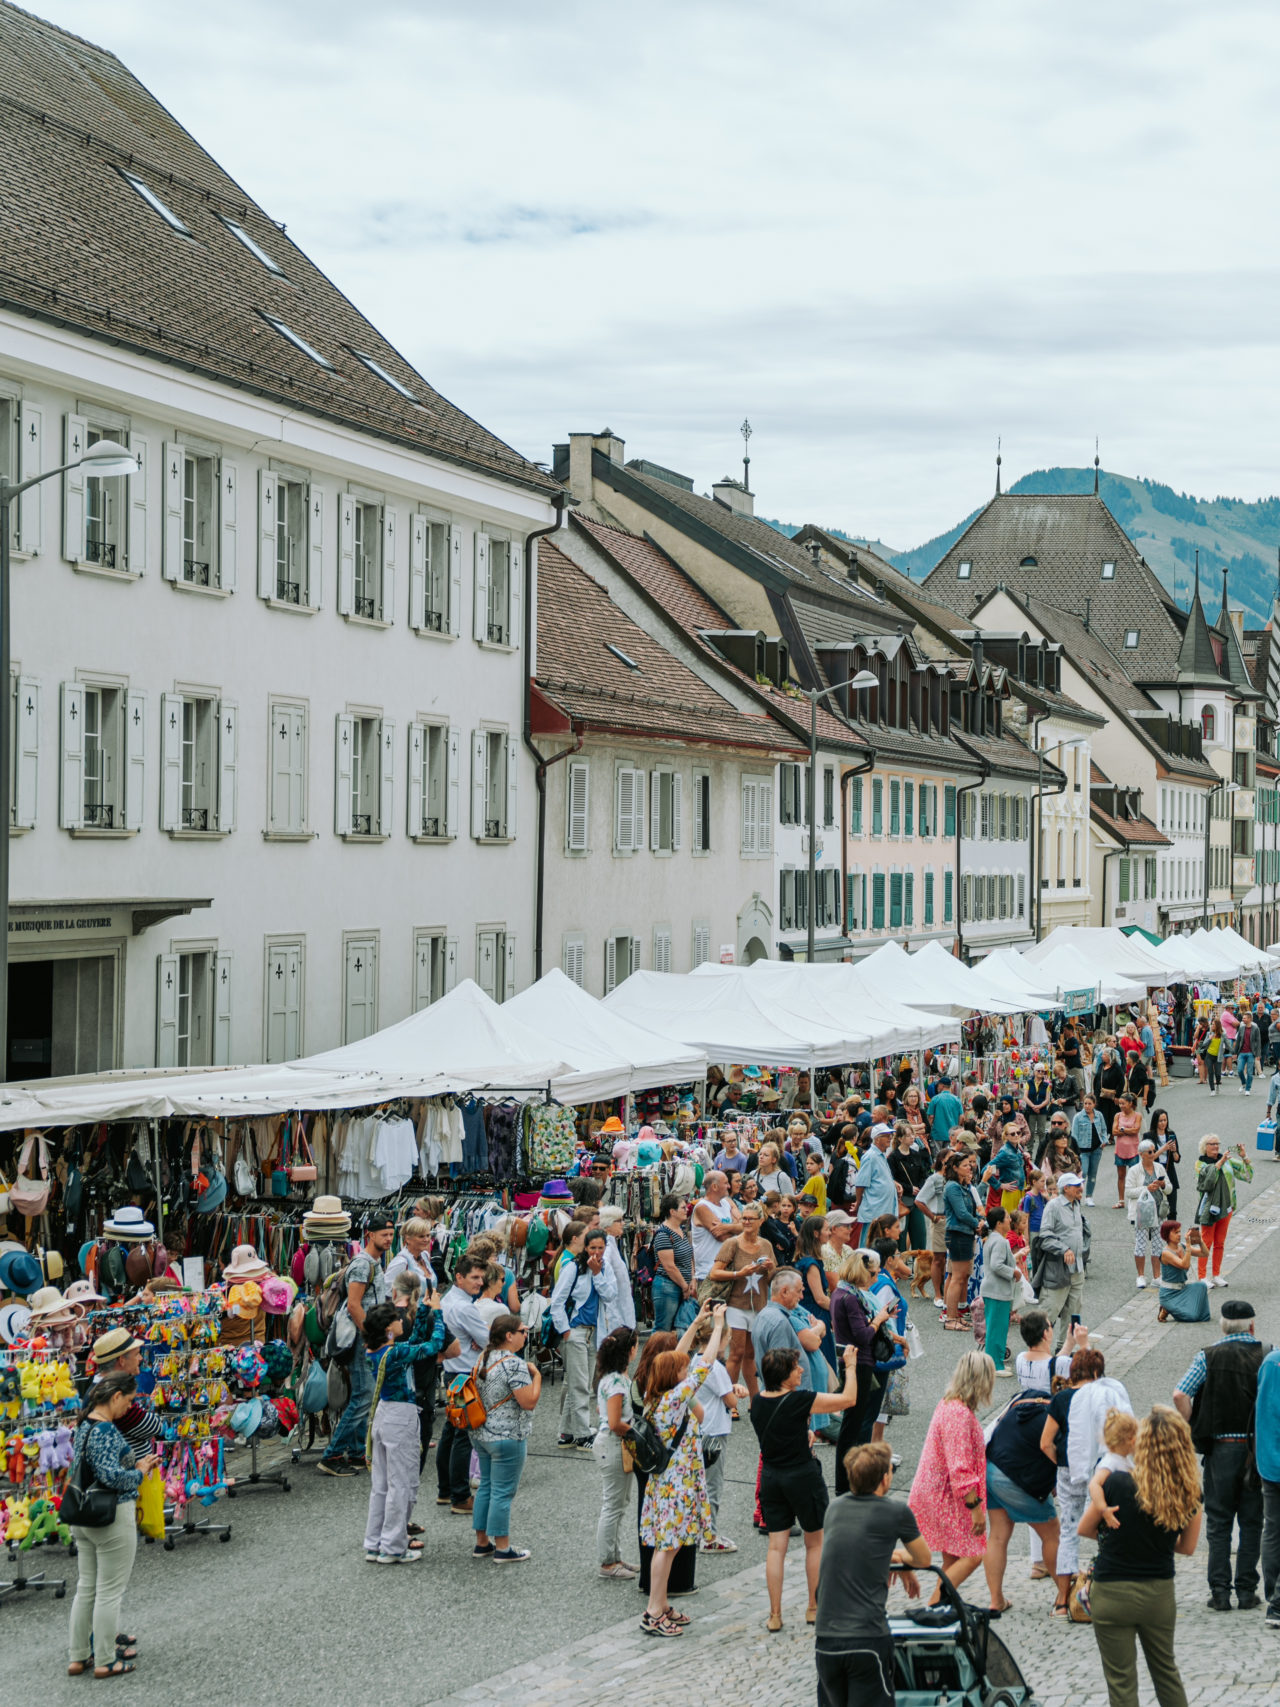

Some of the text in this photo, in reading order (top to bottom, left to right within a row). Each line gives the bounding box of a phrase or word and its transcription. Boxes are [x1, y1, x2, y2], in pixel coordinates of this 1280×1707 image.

[15, 920, 52, 932] MUSIQUE
[54, 920, 65, 929] DE
[66, 919, 75, 929] LA
